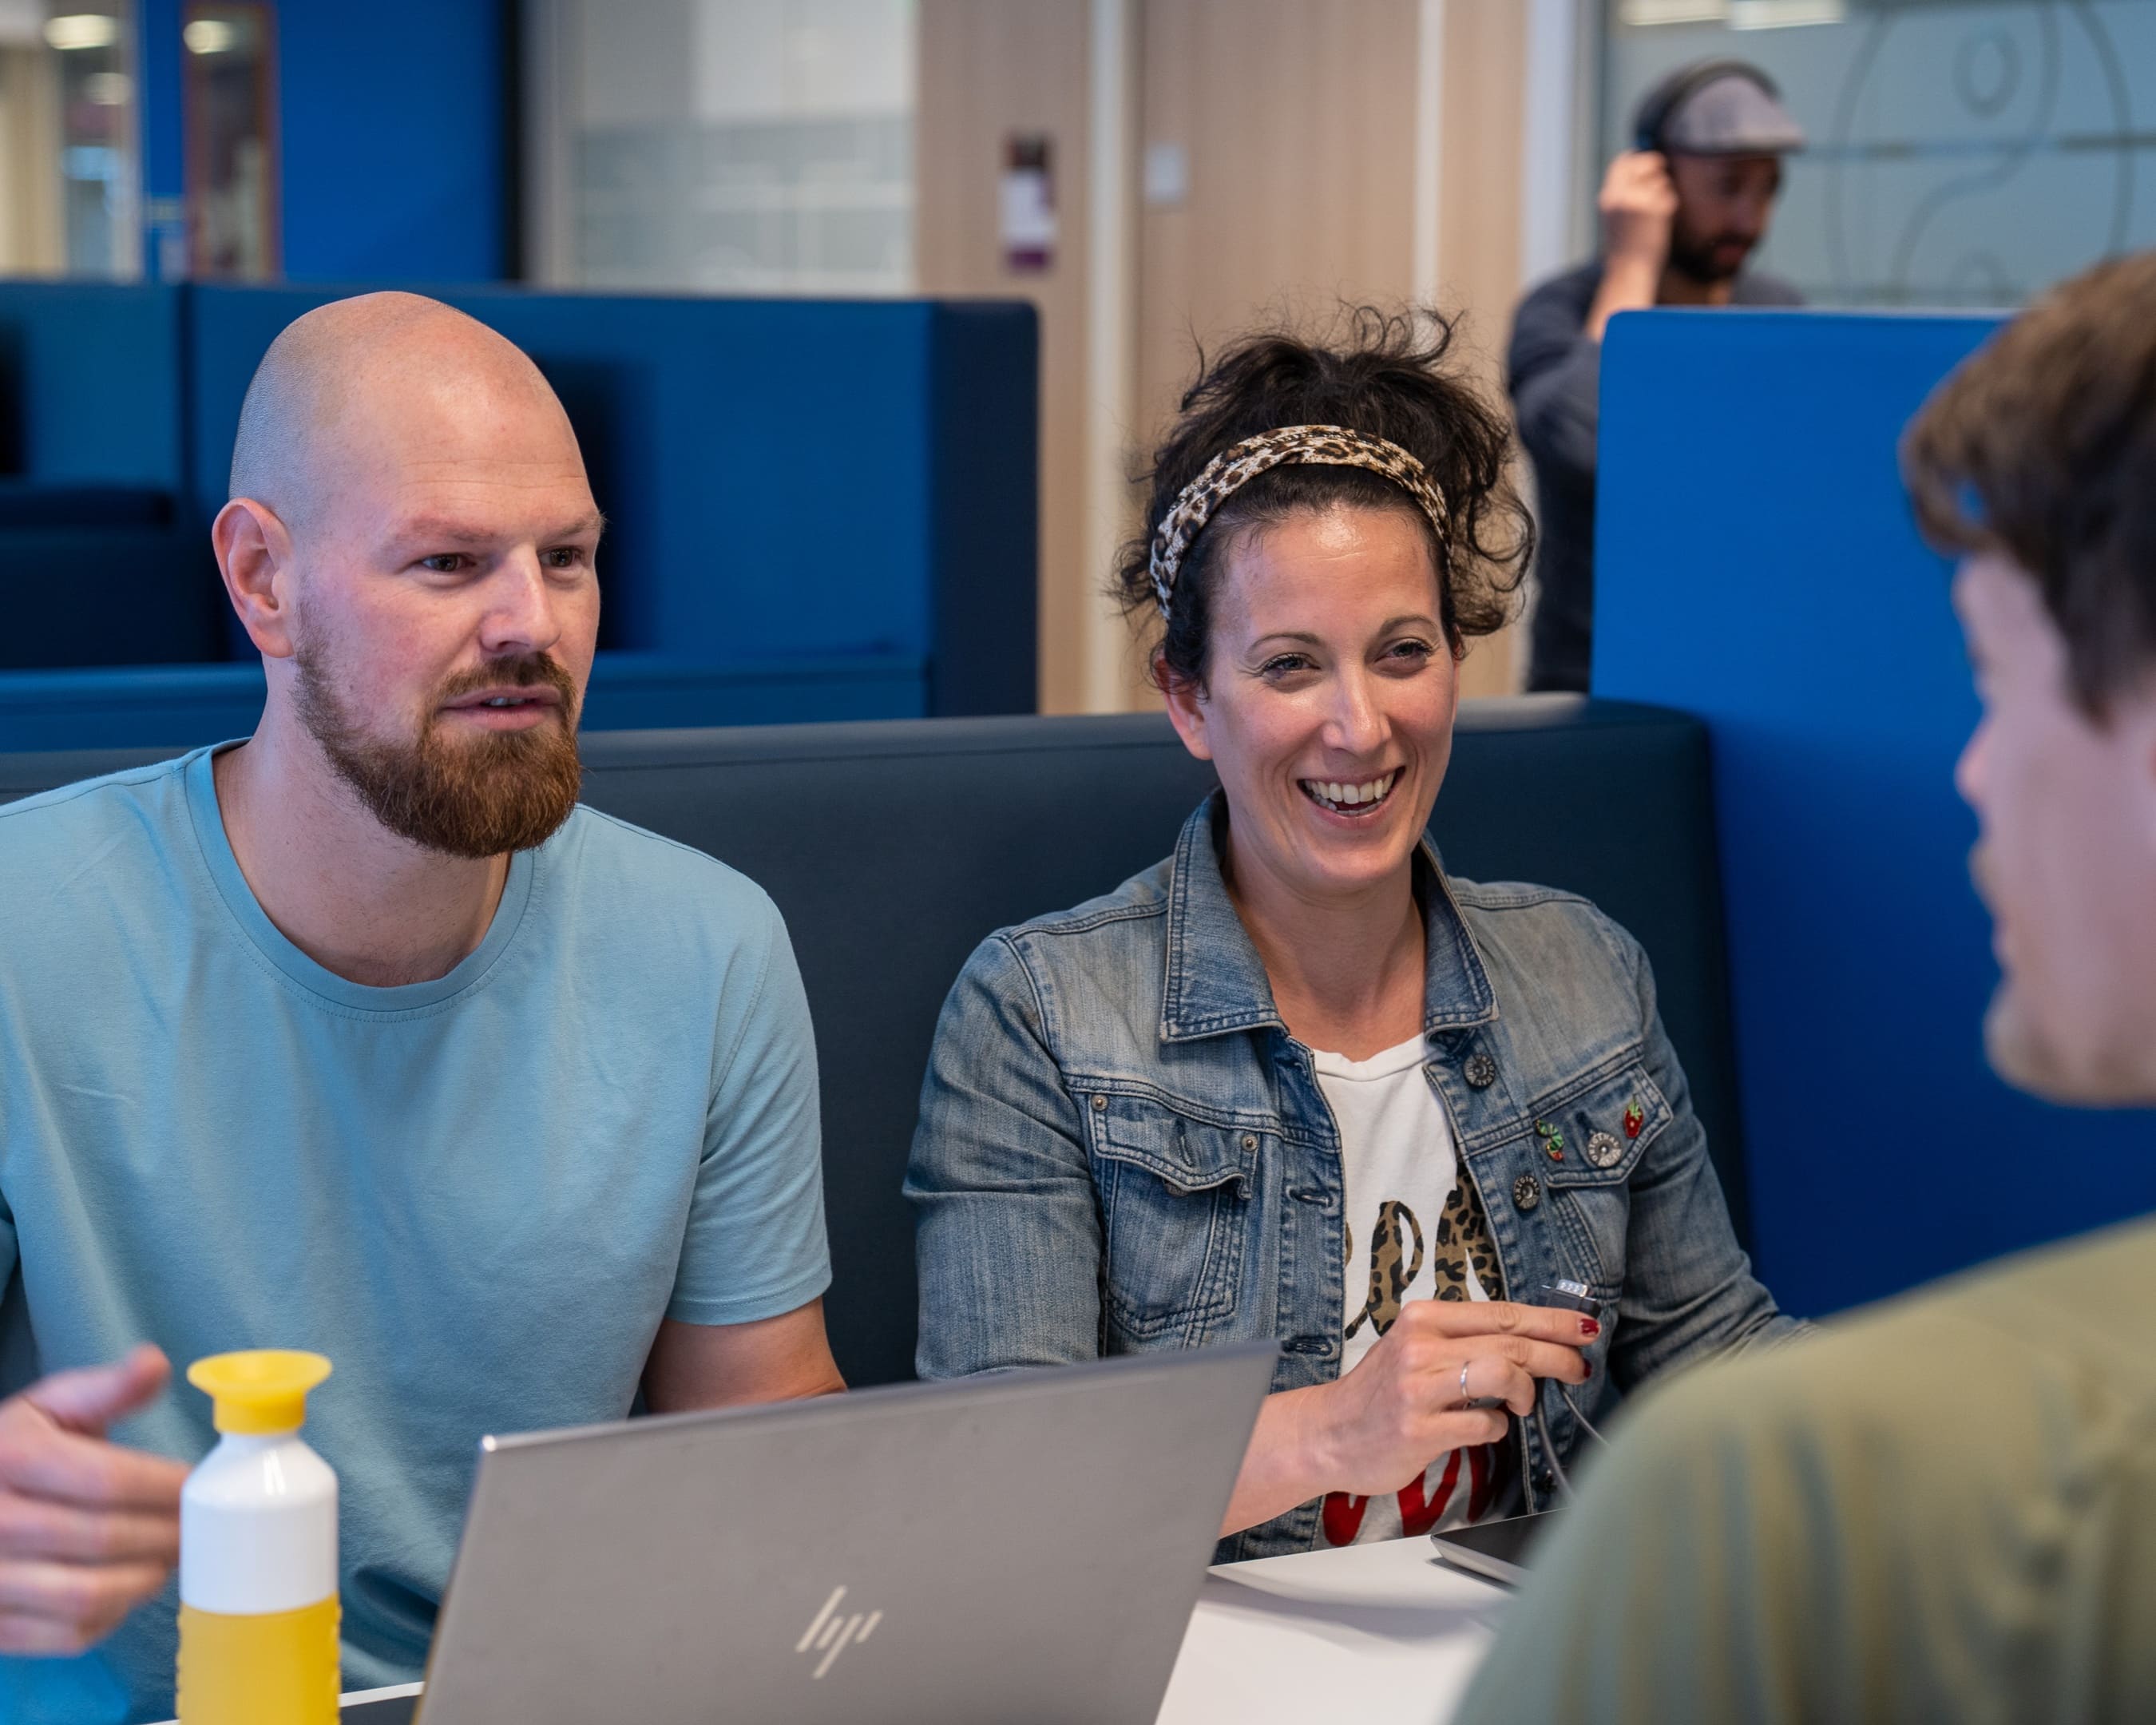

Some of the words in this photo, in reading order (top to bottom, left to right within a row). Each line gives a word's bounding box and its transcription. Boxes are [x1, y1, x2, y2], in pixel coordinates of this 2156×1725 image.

[1588, 1133, 1620, 1162] ORIGINAL
[1515, 1176, 1540, 1200] ORIGINAL
[795, 1584, 883, 1679] hp
